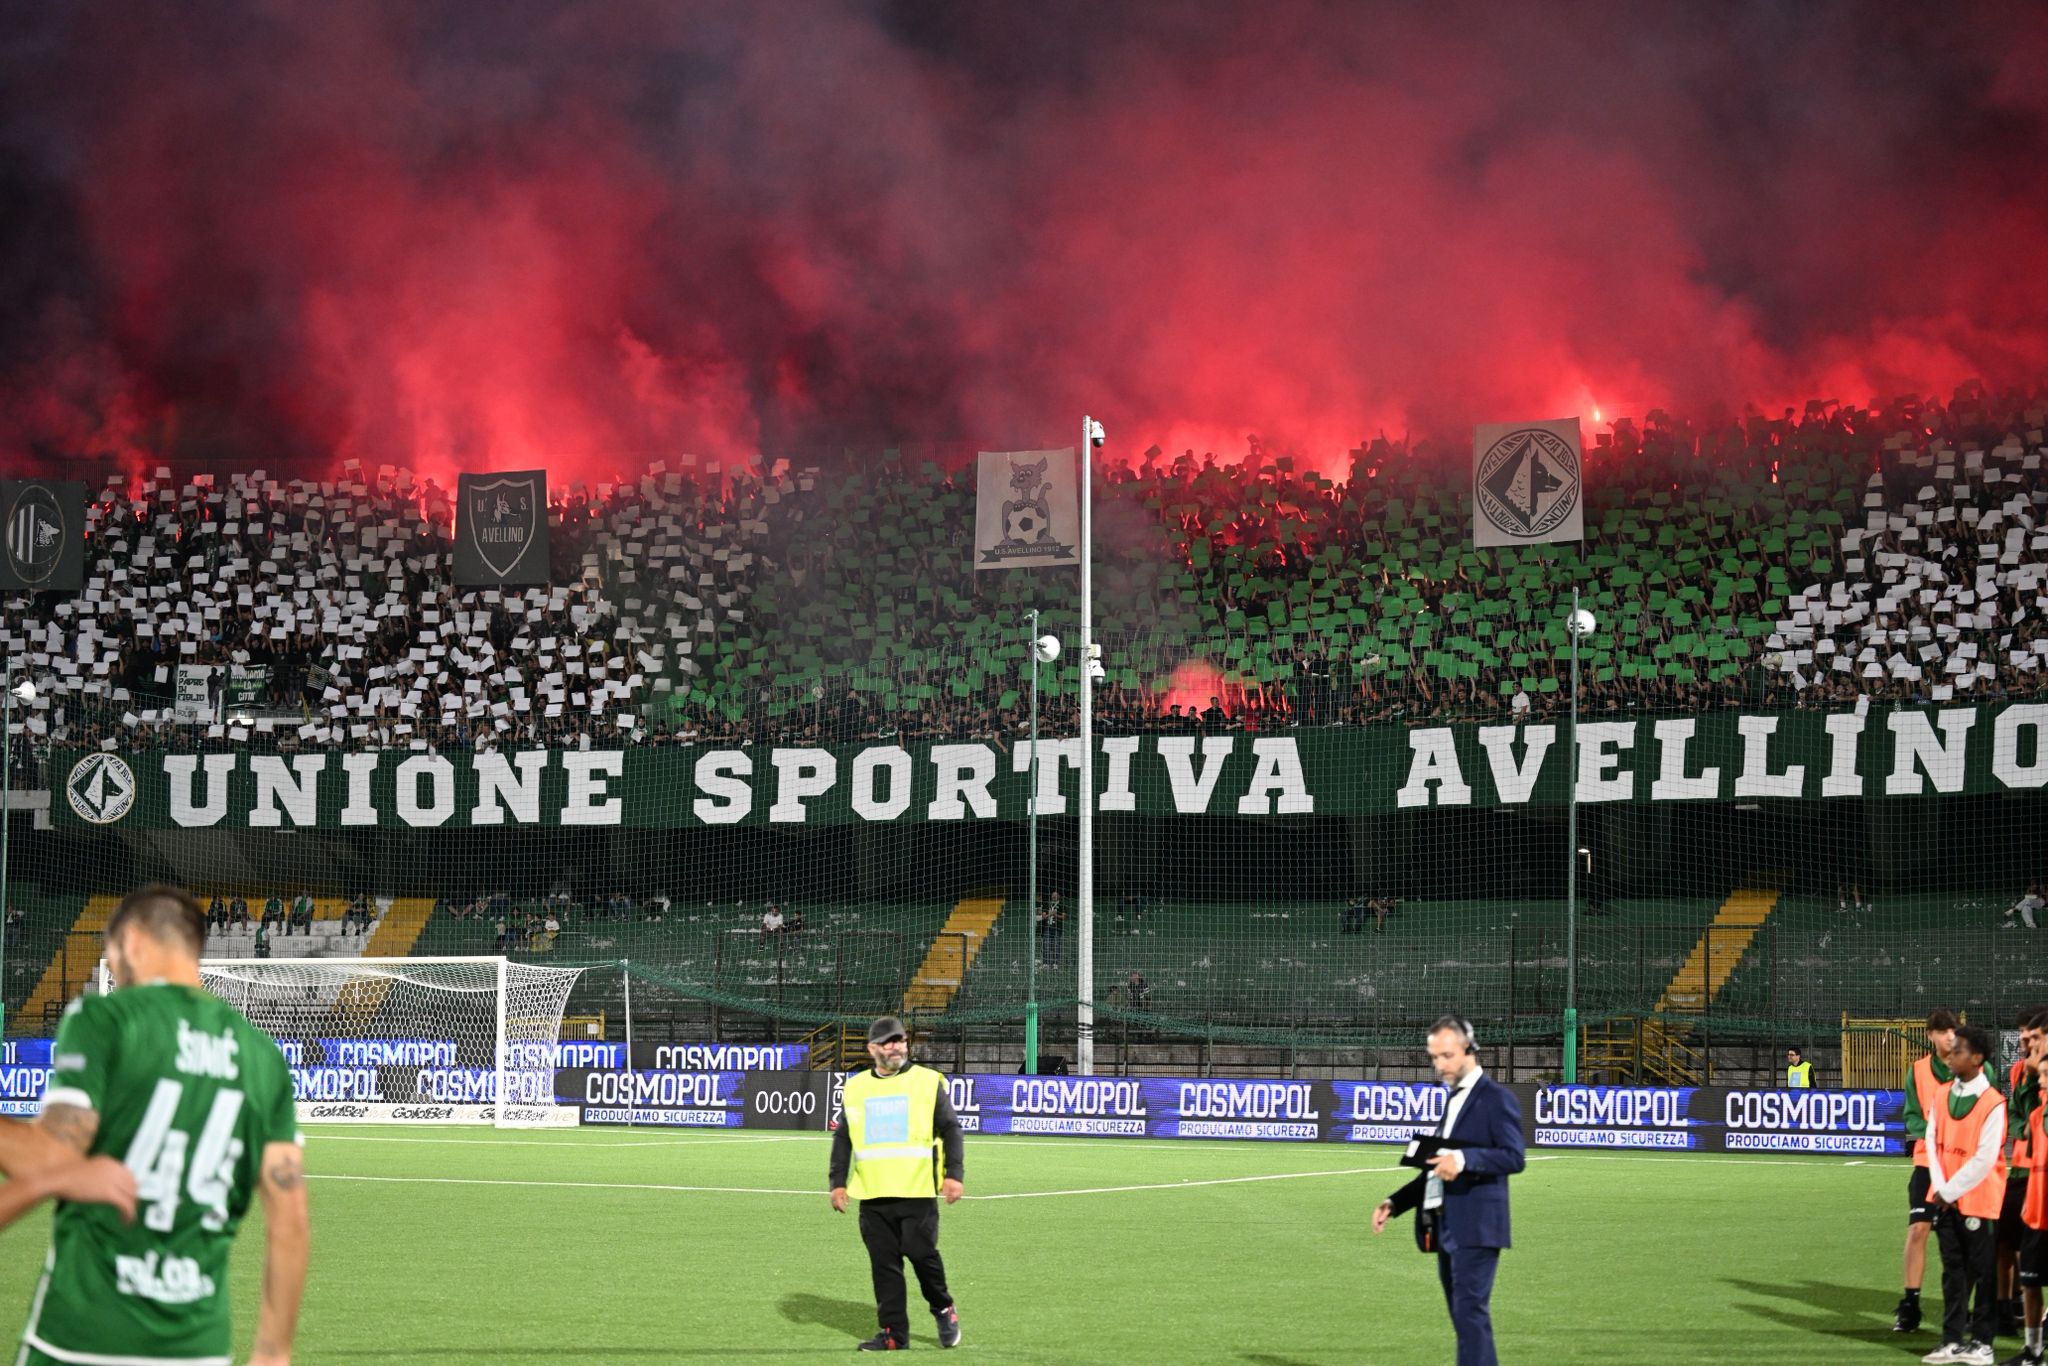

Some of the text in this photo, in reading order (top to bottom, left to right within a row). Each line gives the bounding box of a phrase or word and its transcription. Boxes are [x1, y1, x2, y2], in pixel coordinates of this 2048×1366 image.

[482, 527, 524, 543] AVELLINO
[1007, 546, 1042, 554] AVELLINO
[163, 703, 2048, 828] UNIONE SPORTIVA AVELLINO
[586, 1072, 727, 1106] COSMOPOL
[1013, 1079, 1146, 1115] COSMOPOL
[1180, 1083, 1318, 1119] COSMOPOL
[755, 1090, 816, 1115] 00:00
[1535, 1088, 1688, 1127] COSMOPOL
[1726, 1091, 1885, 1131] COSMOPOL
[663, 1110, 724, 1124] SICUREZZA
[1013, 1119, 1143, 1133] PRODUCIAMO SICUREZZA
[1180, 1123, 1316, 1137] PRODUCIAMO SICUREZZA
[1536, 1130, 1686, 1146] PRODUCIAMO SICUREZZA
[1727, 1134, 1883, 1150] PRODUCIAMO SICUREZZA
[125, 1077, 244, 1232] 44
